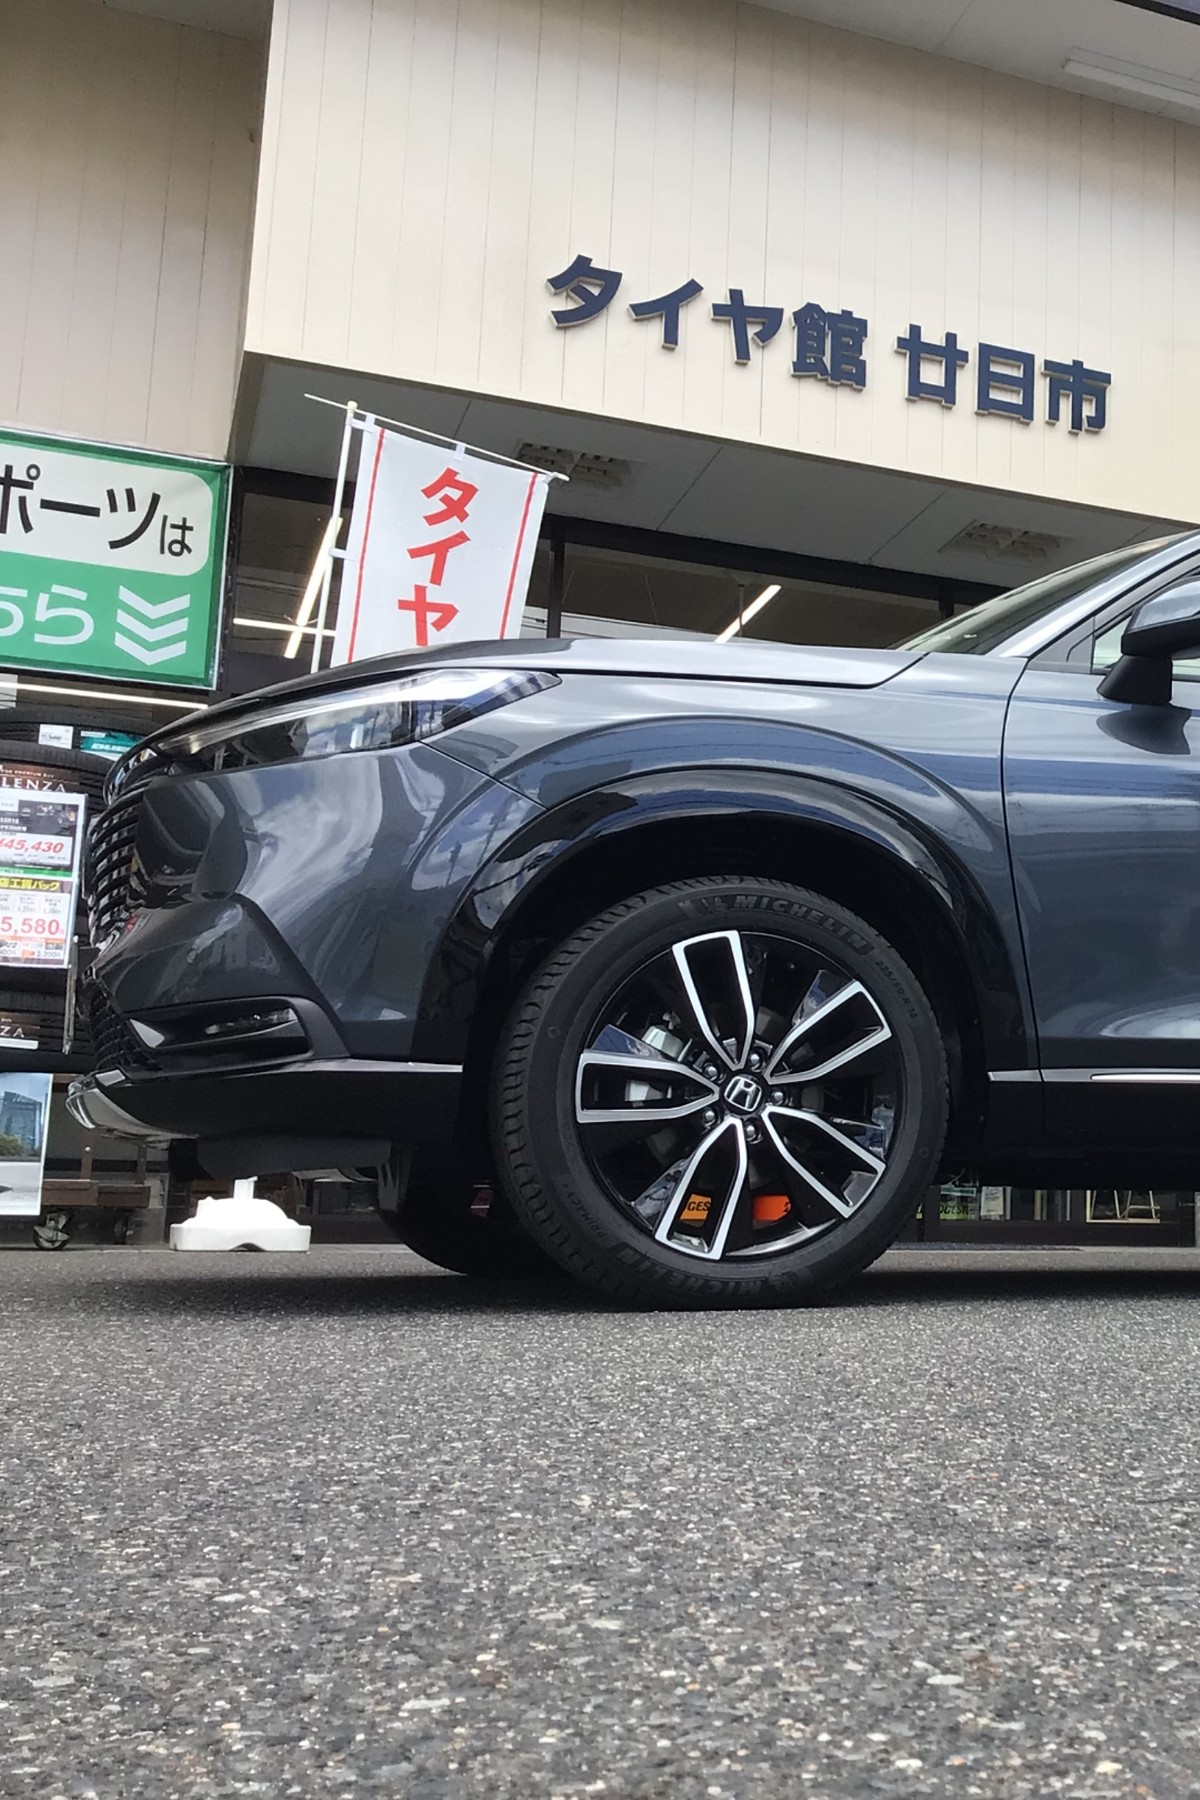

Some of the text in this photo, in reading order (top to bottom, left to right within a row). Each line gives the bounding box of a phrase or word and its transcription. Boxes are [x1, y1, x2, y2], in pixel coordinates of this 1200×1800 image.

[545, 253, 1112, 434] タイヤ館 廿日市
[397, 467, 479, 647] タイヤ
[733, 895, 873, 951] MICHELIN
